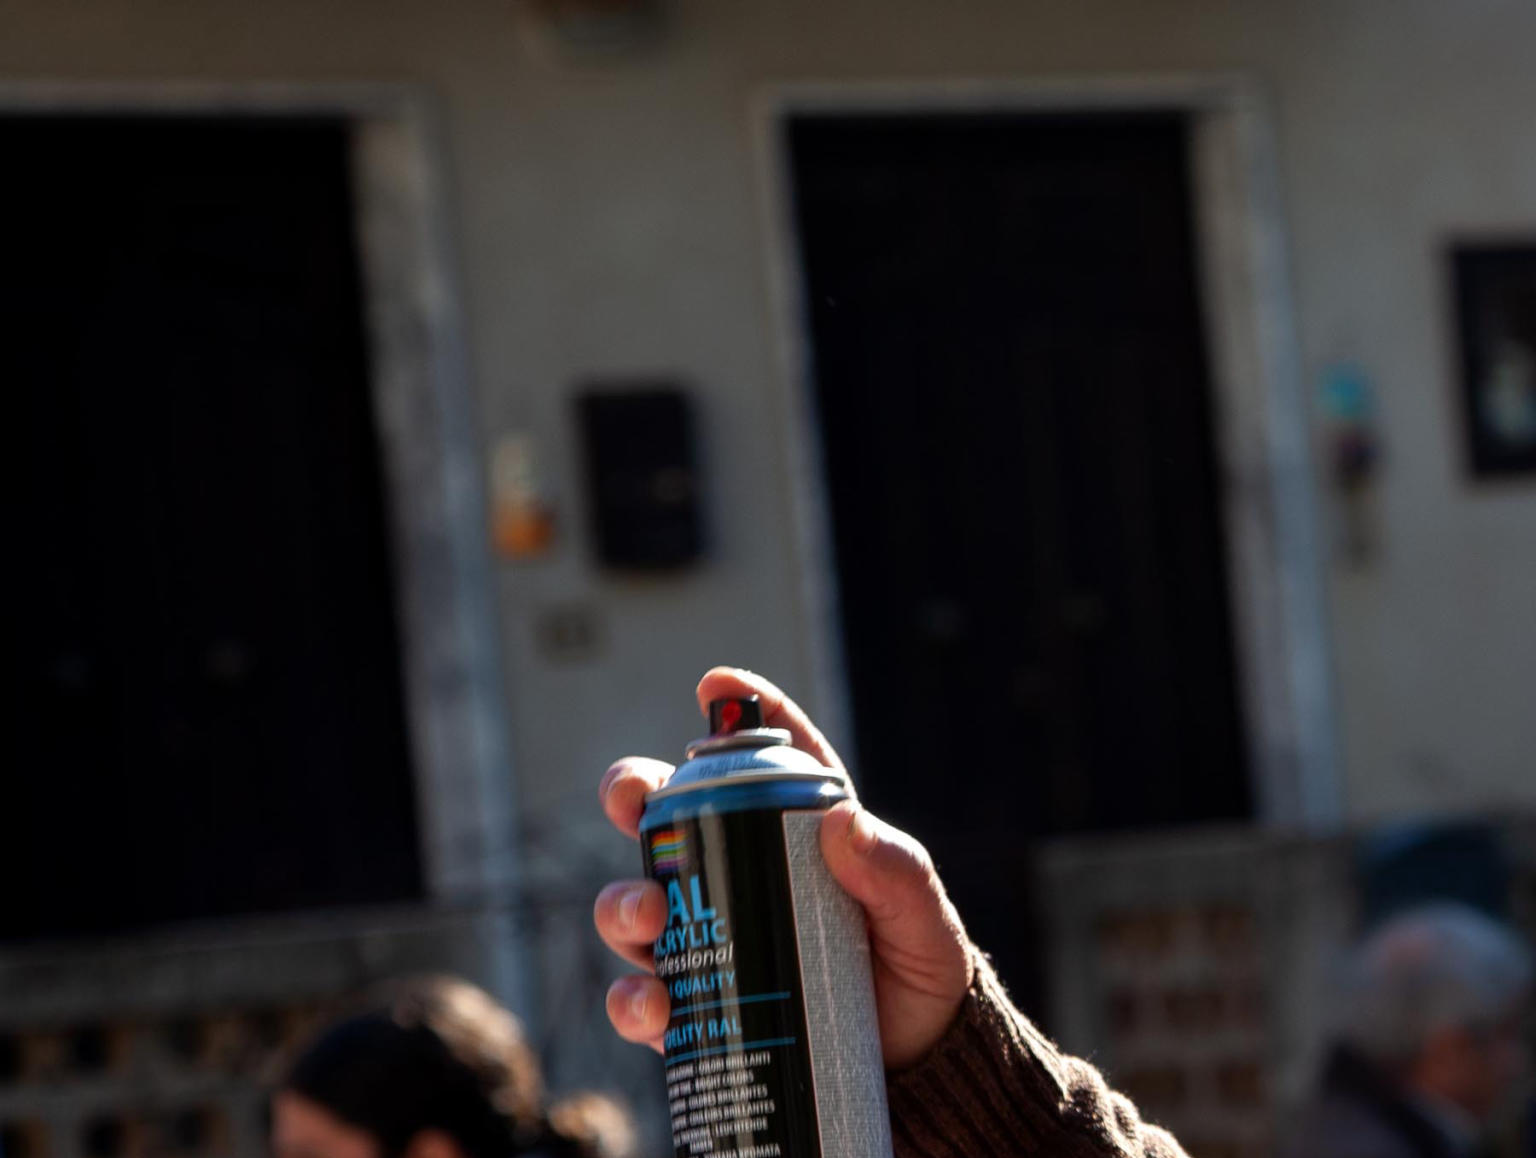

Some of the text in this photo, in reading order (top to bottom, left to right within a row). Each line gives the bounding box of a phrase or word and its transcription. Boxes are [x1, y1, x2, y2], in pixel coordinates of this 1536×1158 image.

[667, 873, 716, 928] AL
[656, 940, 733, 977] rofessional
[674, 969, 736, 999] QUALITY
[708, 1015, 742, 1040] RAL
